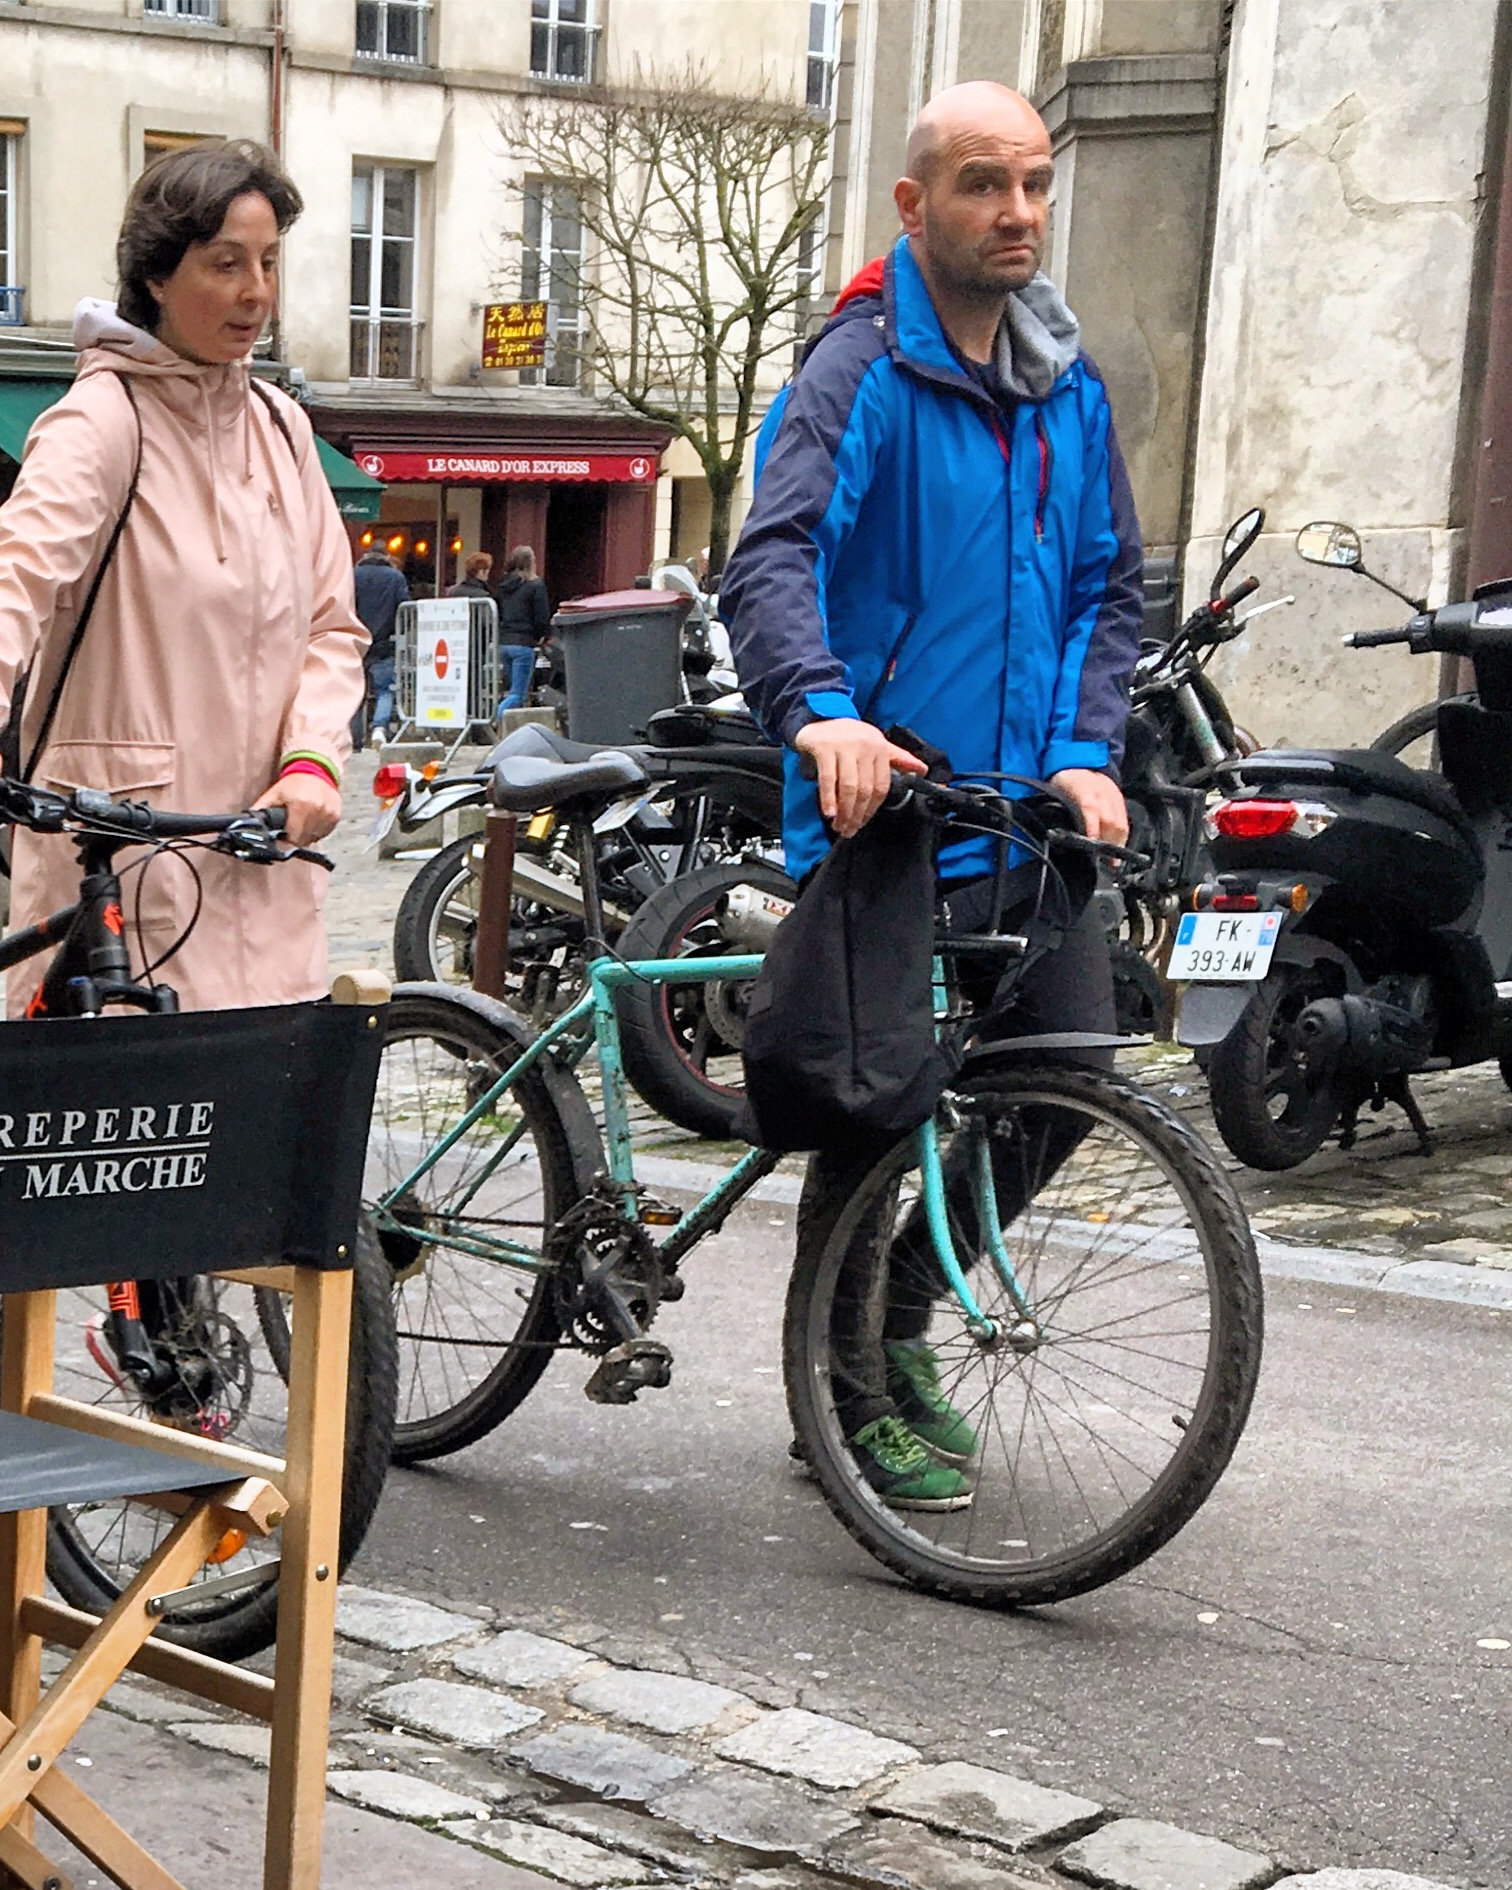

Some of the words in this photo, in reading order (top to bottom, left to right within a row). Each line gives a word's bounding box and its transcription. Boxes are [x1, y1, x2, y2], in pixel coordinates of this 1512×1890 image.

[426, 458, 447, 473] LE
[448, 458, 499, 474] CANARD
[501, 460, 530, 474] D'OR
[532, 460, 589, 475] EXPRESS
[1187, 950, 1257, 972] 393-AW
[20, 1153, 207, 1200] MARCHE
